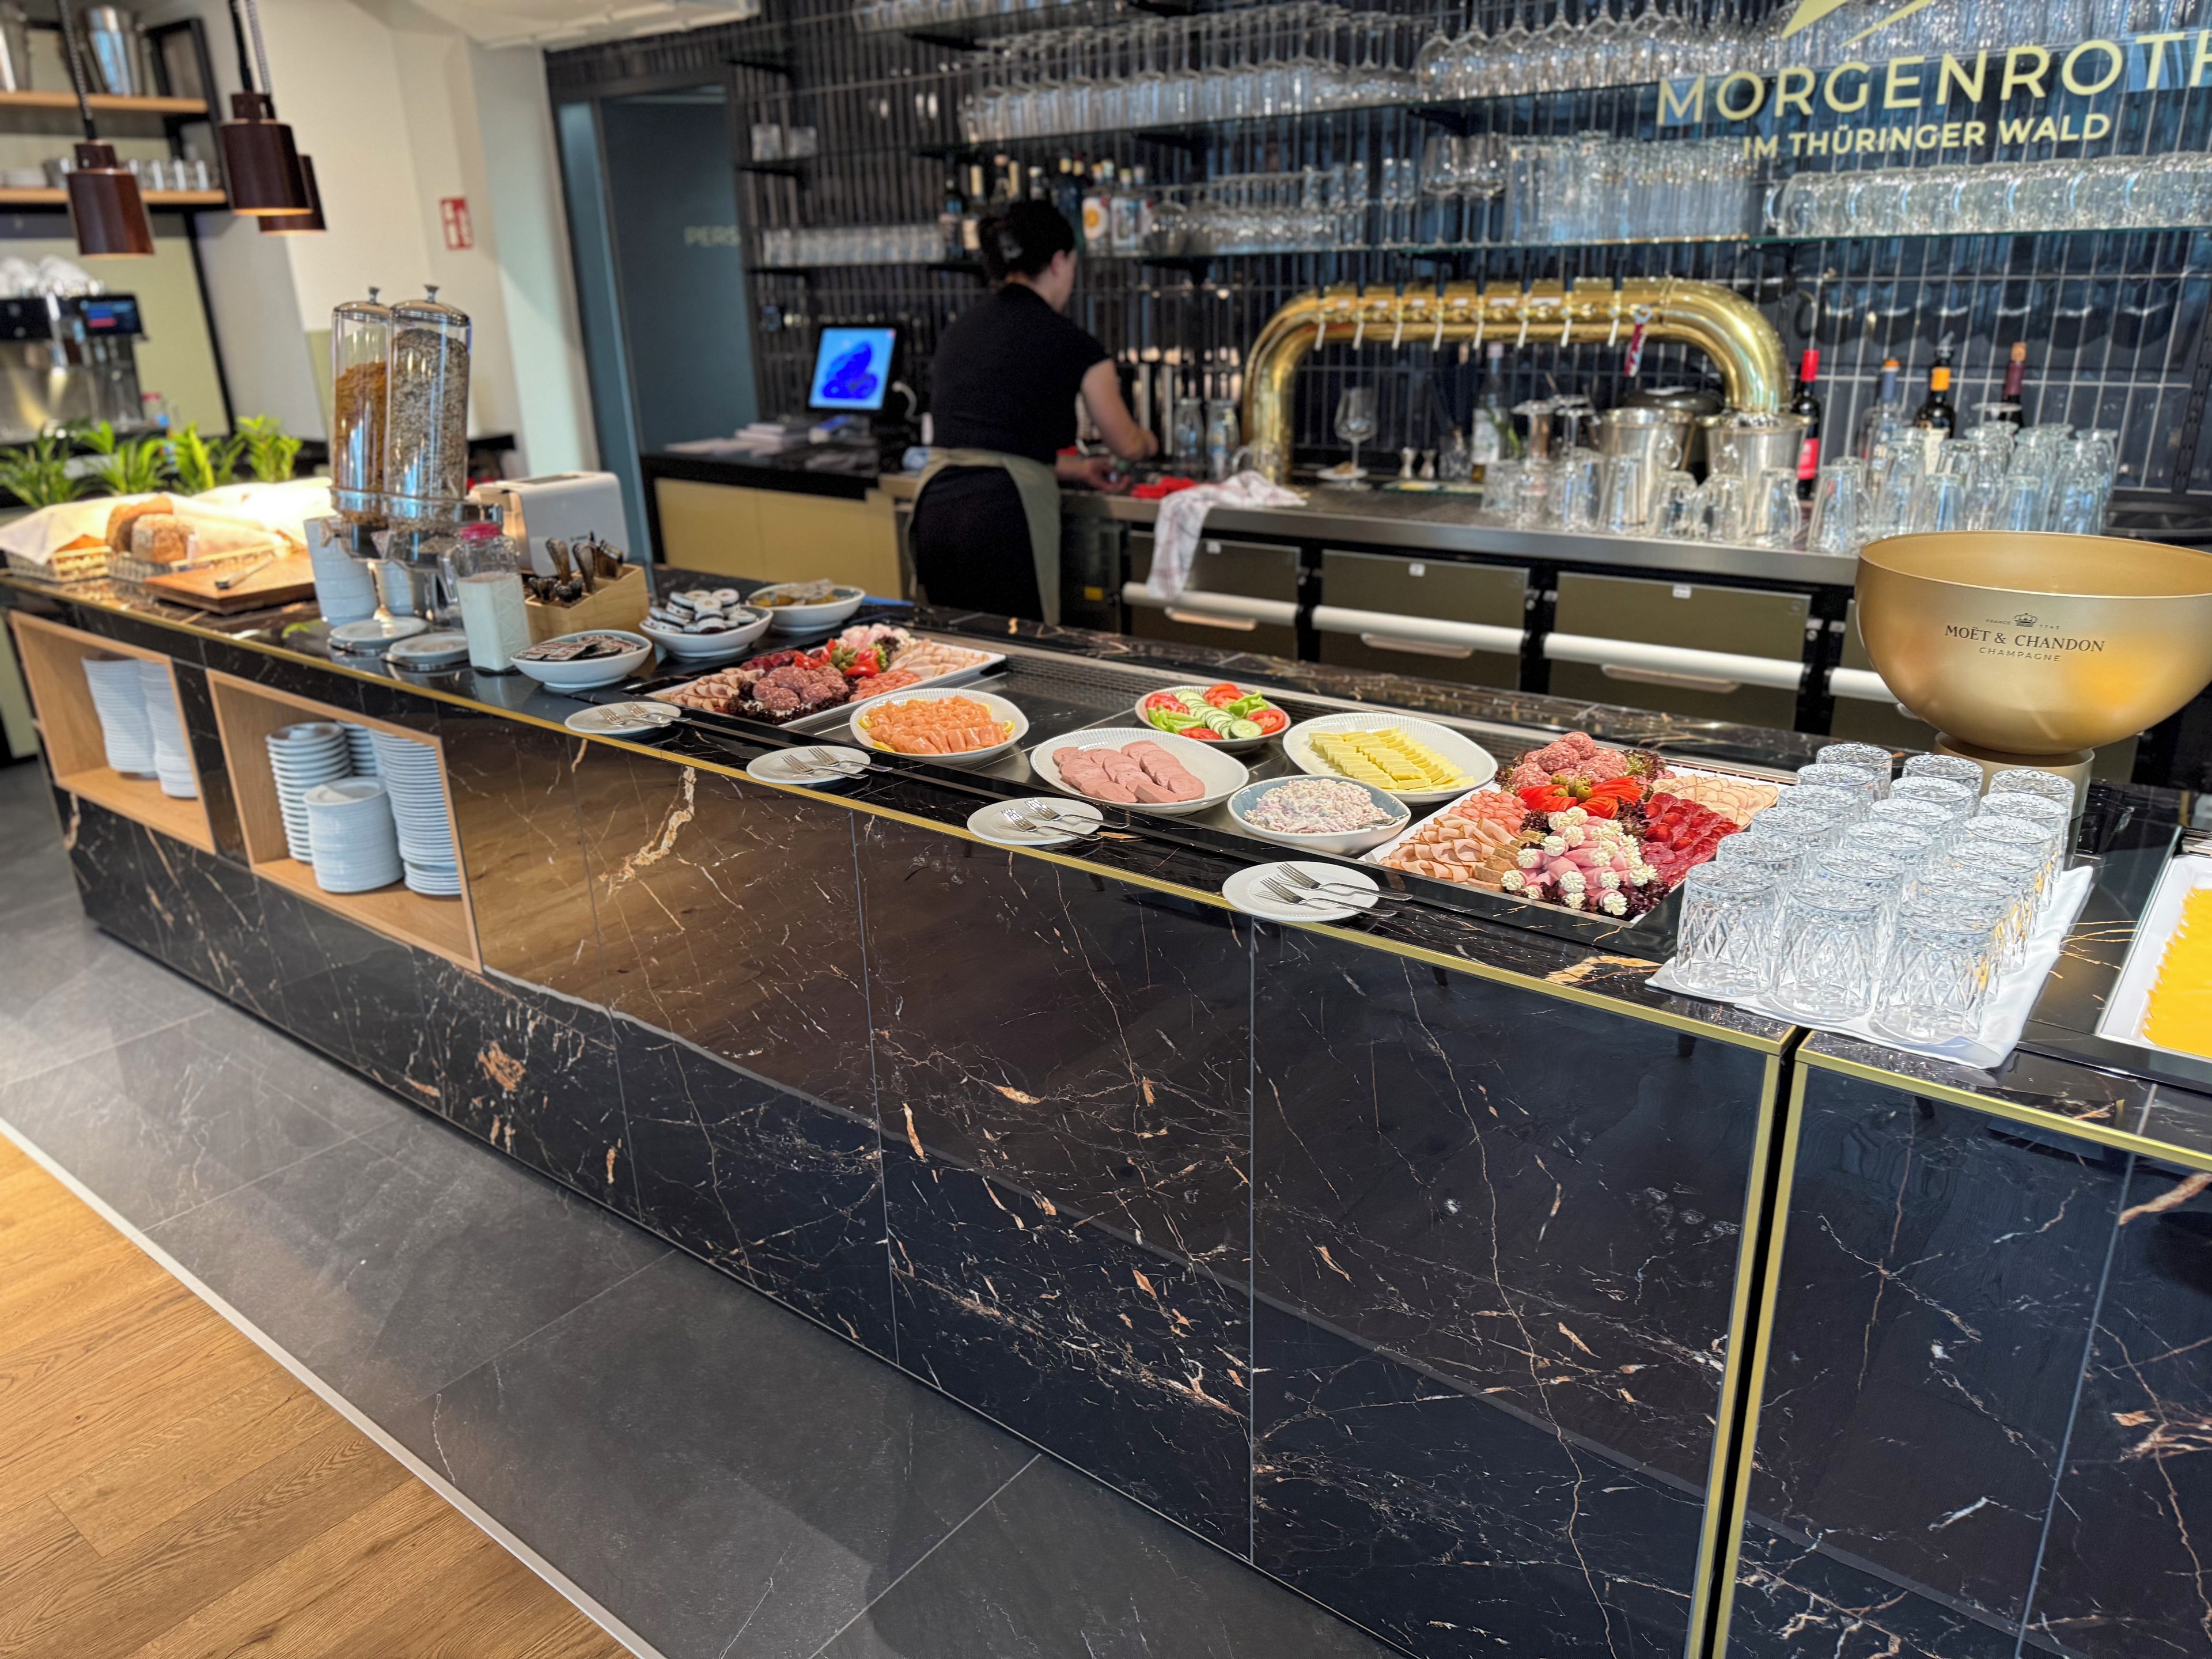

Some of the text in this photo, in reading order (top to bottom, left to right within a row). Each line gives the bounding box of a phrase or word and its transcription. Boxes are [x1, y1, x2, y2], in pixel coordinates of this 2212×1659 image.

[1743, 113, 2111, 160] IM THÜRINGER WALD
[1945, 625, 2106, 652] MOËT & CHANDON
[1979, 647, 2061, 662] CHAMPAGNE
